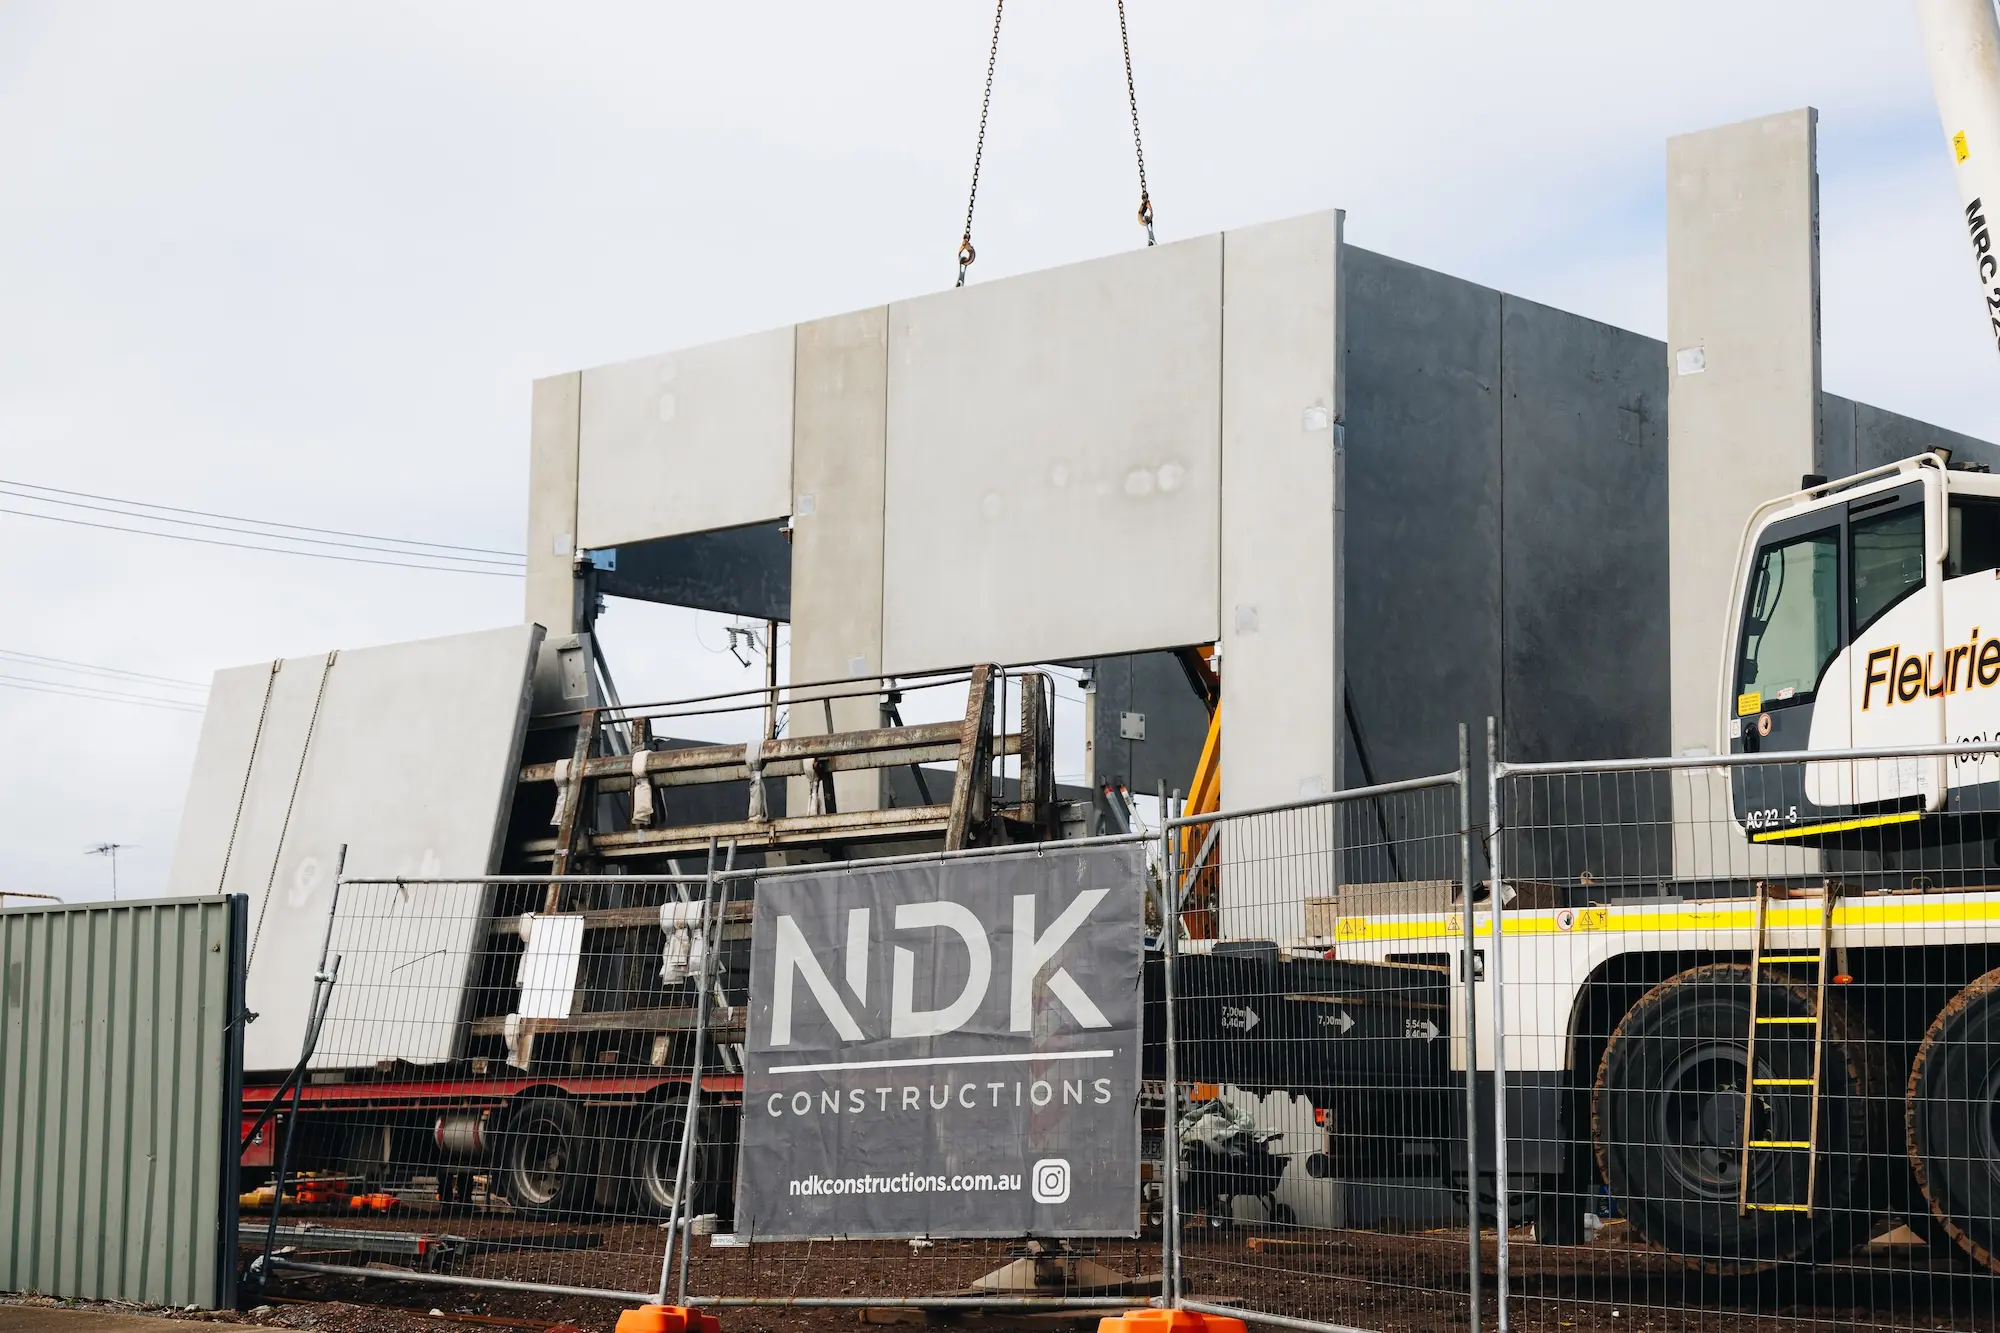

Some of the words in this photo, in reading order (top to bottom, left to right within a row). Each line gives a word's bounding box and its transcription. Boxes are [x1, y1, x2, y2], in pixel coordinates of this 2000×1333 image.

[1965, 196, 1997, 285] MRC
[1862, 625, 2000, 712] Fleurie
[770, 888, 1113, 1046] NDK
[767, 1078, 1112, 1117] CONSTRUCTIONS
[789, 1171, 1022, 1196] ndkconstructions.com.au
